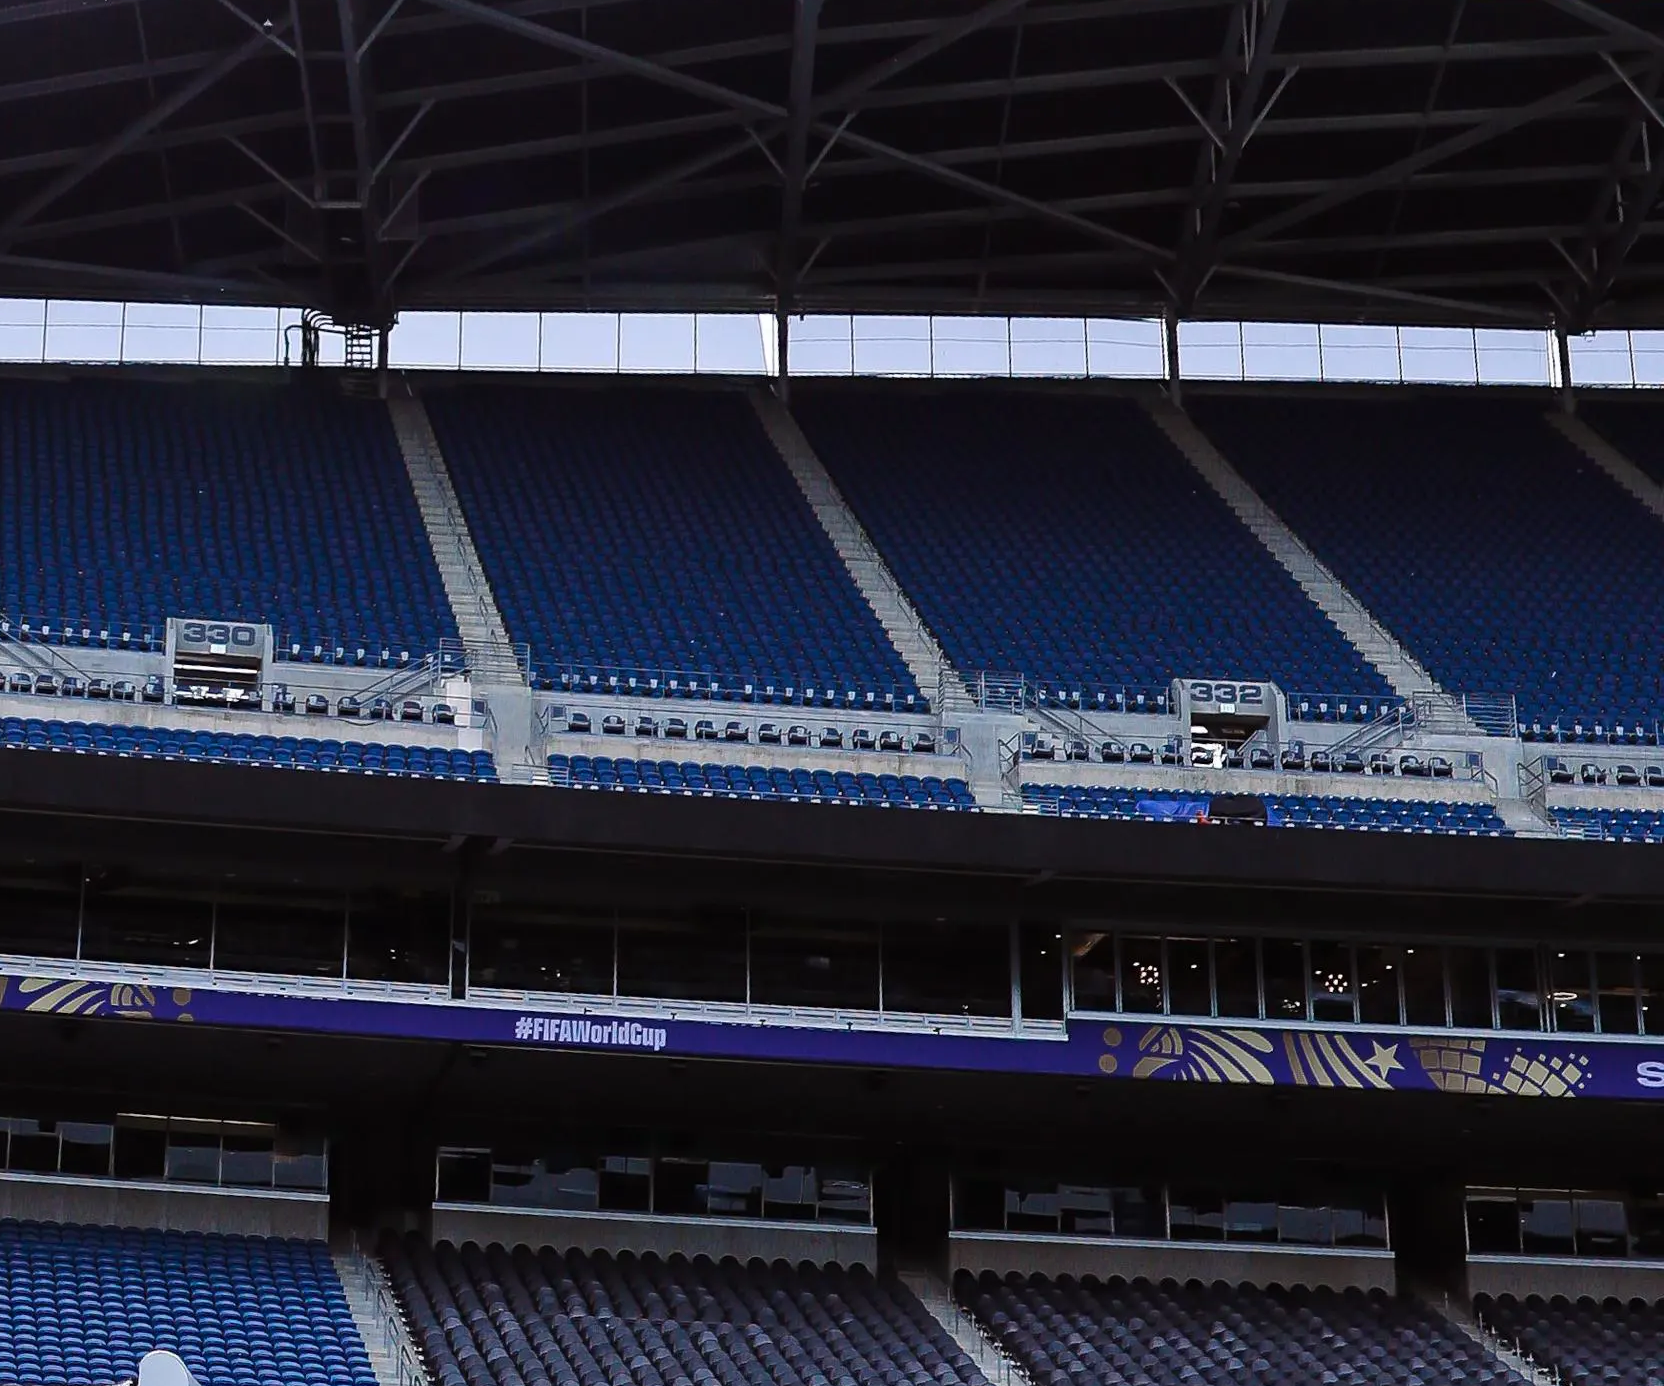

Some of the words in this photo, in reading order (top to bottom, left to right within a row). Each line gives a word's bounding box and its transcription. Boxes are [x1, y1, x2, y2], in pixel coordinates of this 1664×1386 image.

[183, 622, 256, 646] 330
[1190, 682, 1263, 705] 332
[515, 1016, 667, 1051] #FIFAWorldCup
